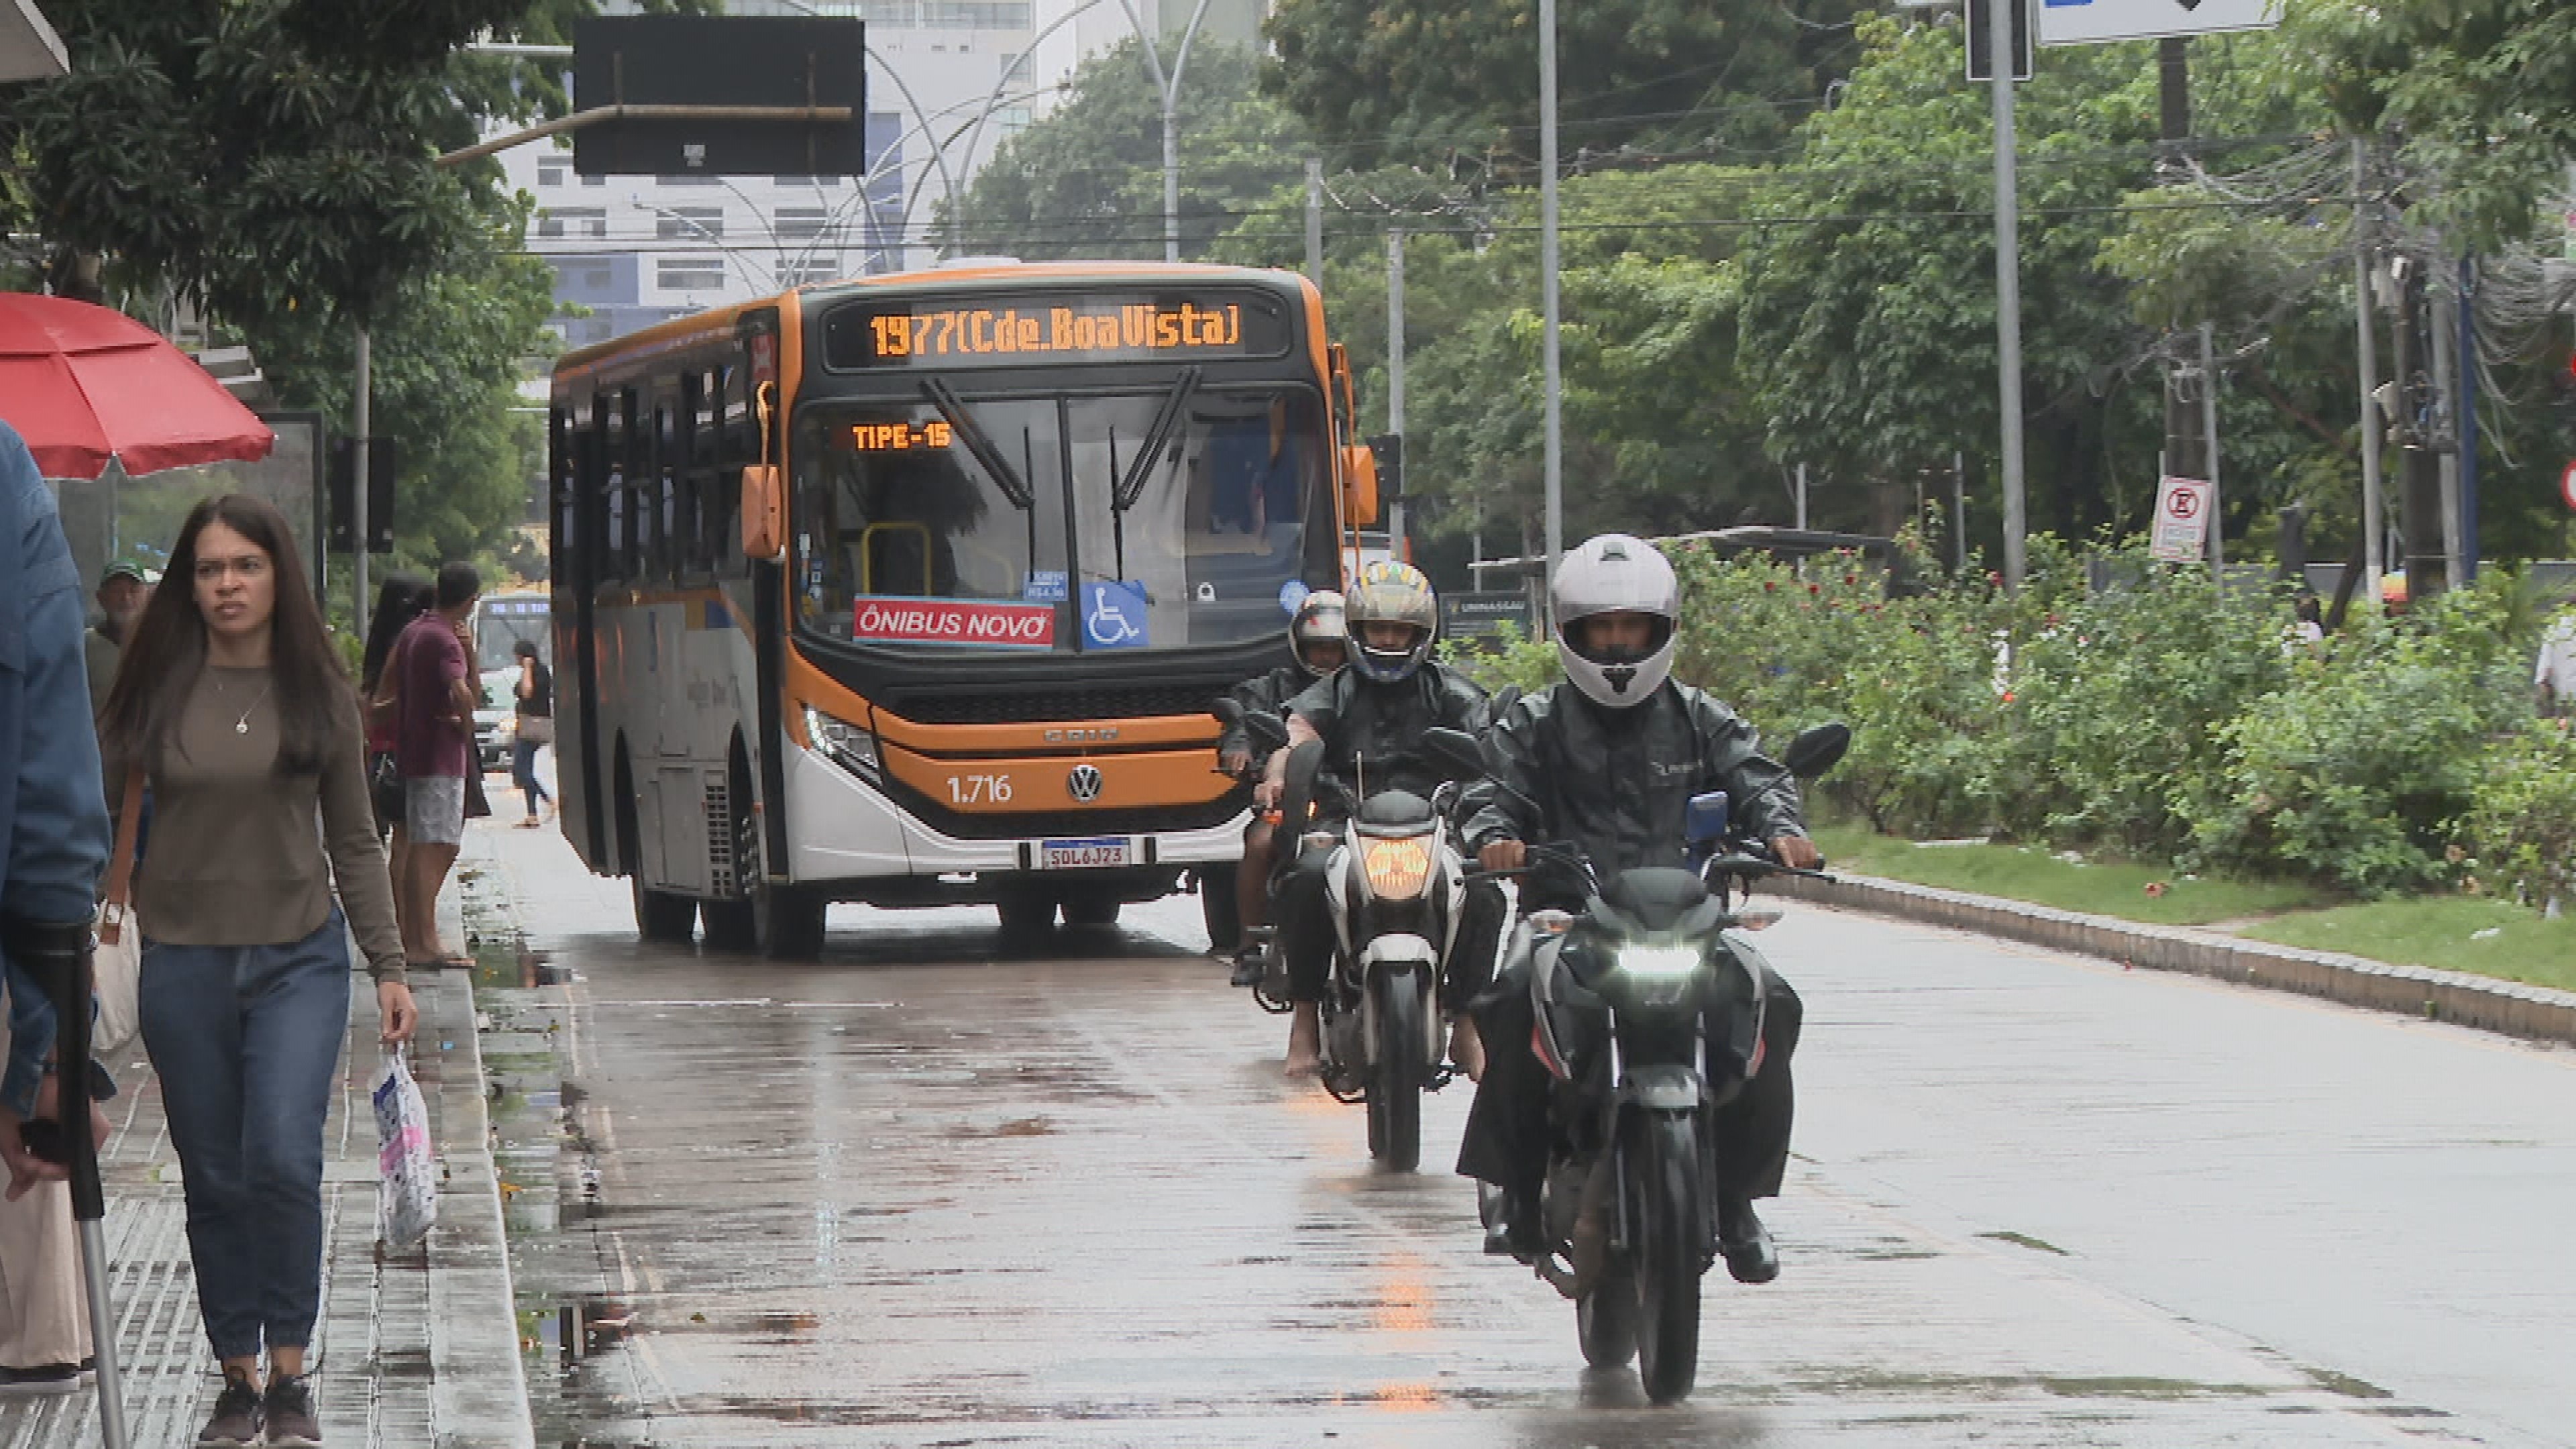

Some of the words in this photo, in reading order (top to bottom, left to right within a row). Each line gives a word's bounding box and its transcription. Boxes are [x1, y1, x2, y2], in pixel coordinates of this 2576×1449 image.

[852, 423, 951, 449] TIPE-15
[859, 604, 962, 635] ÔNIBUS
[967, 614, 1046, 639] NOVO
[947, 775, 1013, 803] 1.716
